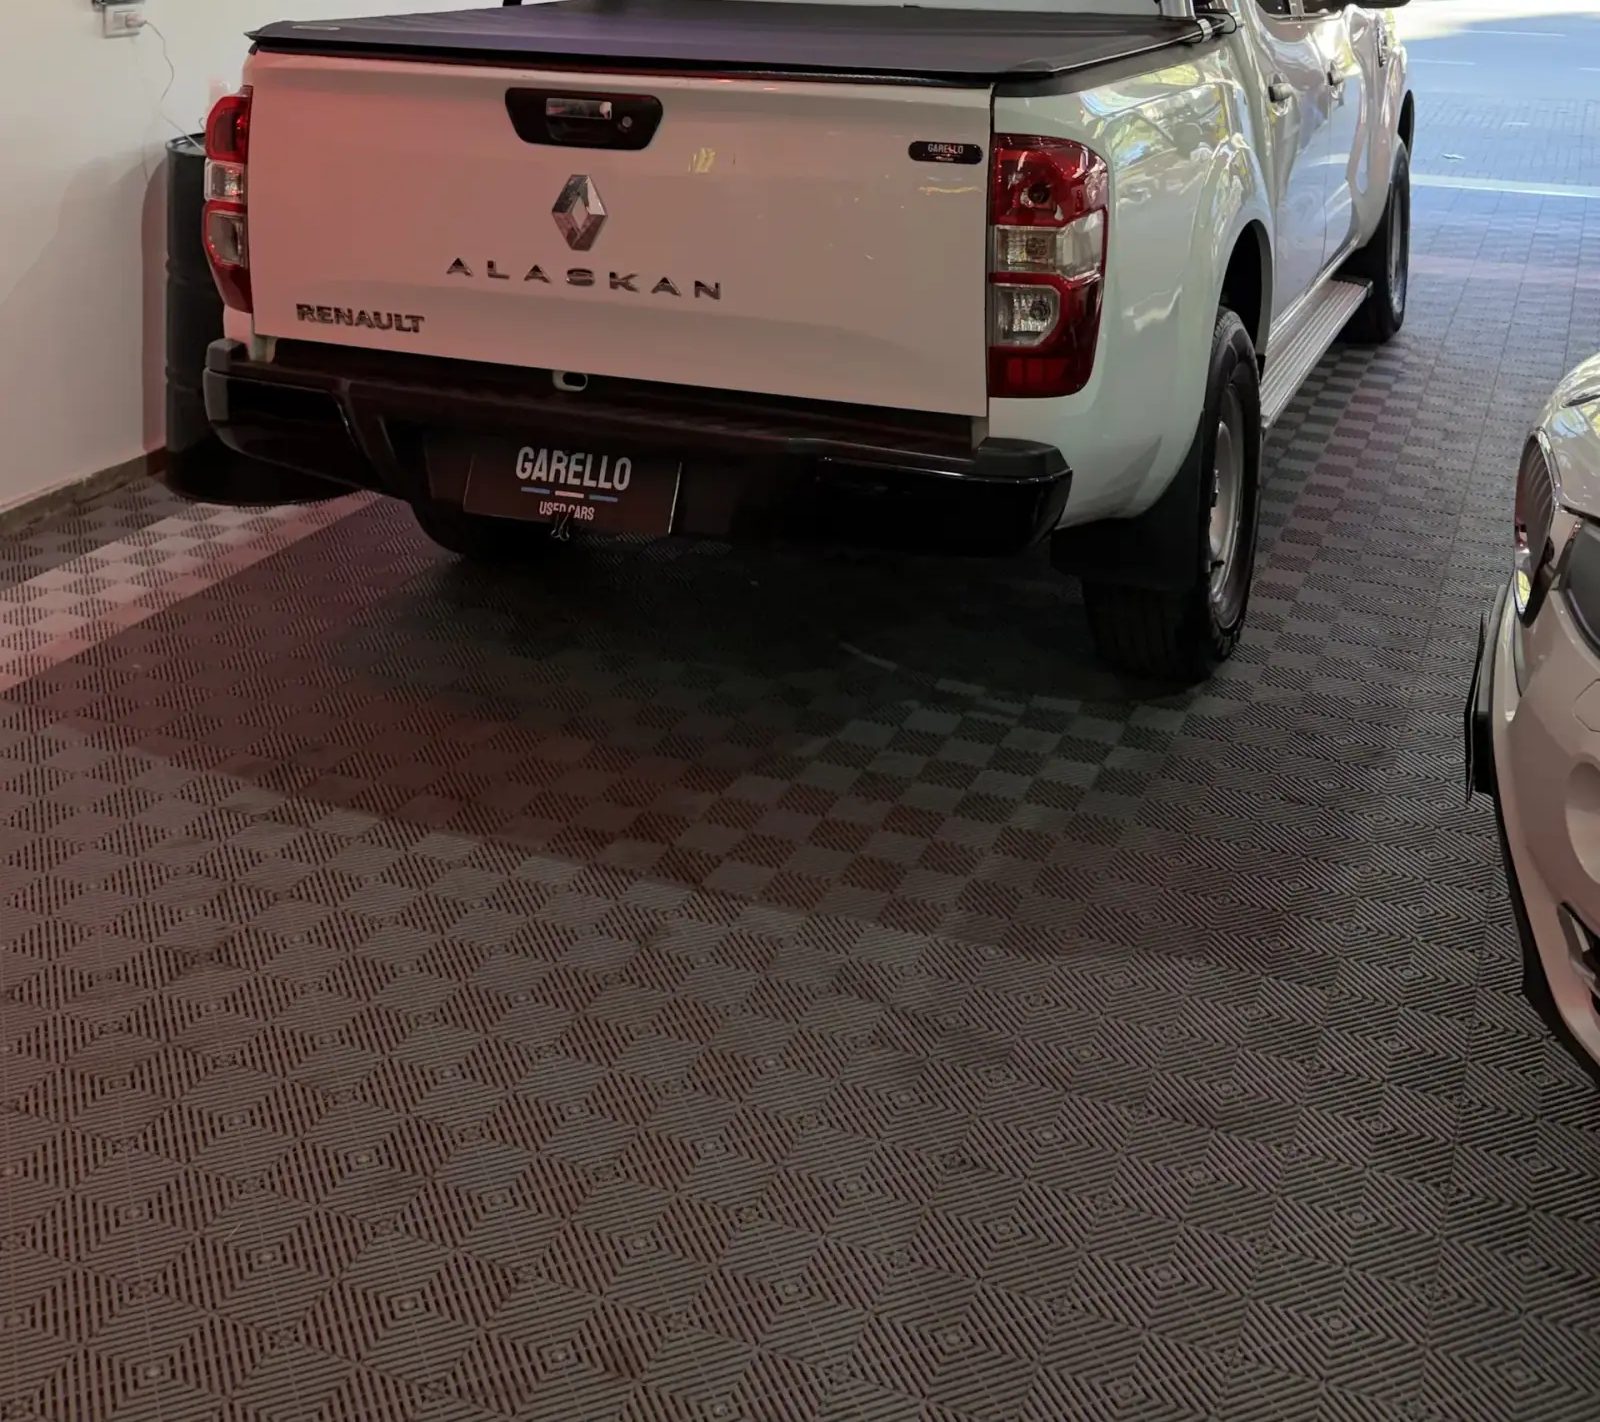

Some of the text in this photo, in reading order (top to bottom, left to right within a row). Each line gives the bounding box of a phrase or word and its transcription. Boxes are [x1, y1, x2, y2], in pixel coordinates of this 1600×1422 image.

[927, 143, 964, 154] GARELLO
[446, 257, 721, 300] ALASKAN
[296, 303, 425, 333] RENAULT
[515, 446, 632, 491] GARELLO
